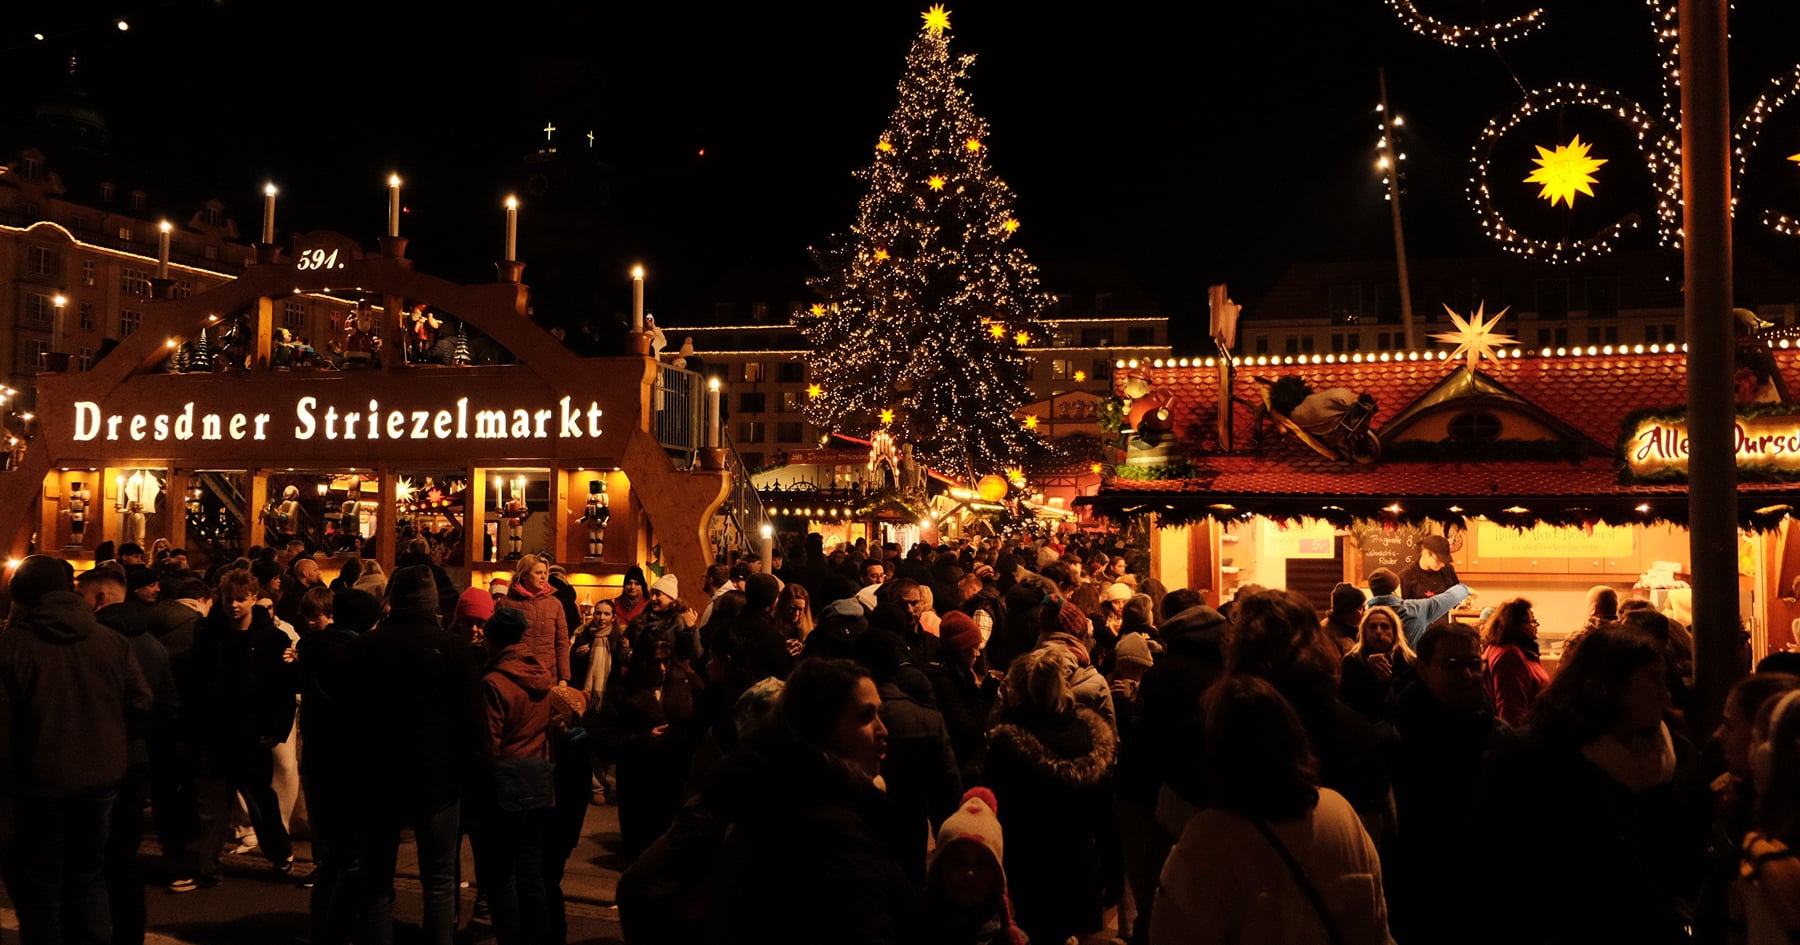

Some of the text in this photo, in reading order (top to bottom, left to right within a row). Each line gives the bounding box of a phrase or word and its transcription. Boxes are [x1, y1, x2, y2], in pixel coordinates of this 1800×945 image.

[297, 249, 344, 270] 591.
[73, 396, 602, 441] Dresdner Striezelmarkt
